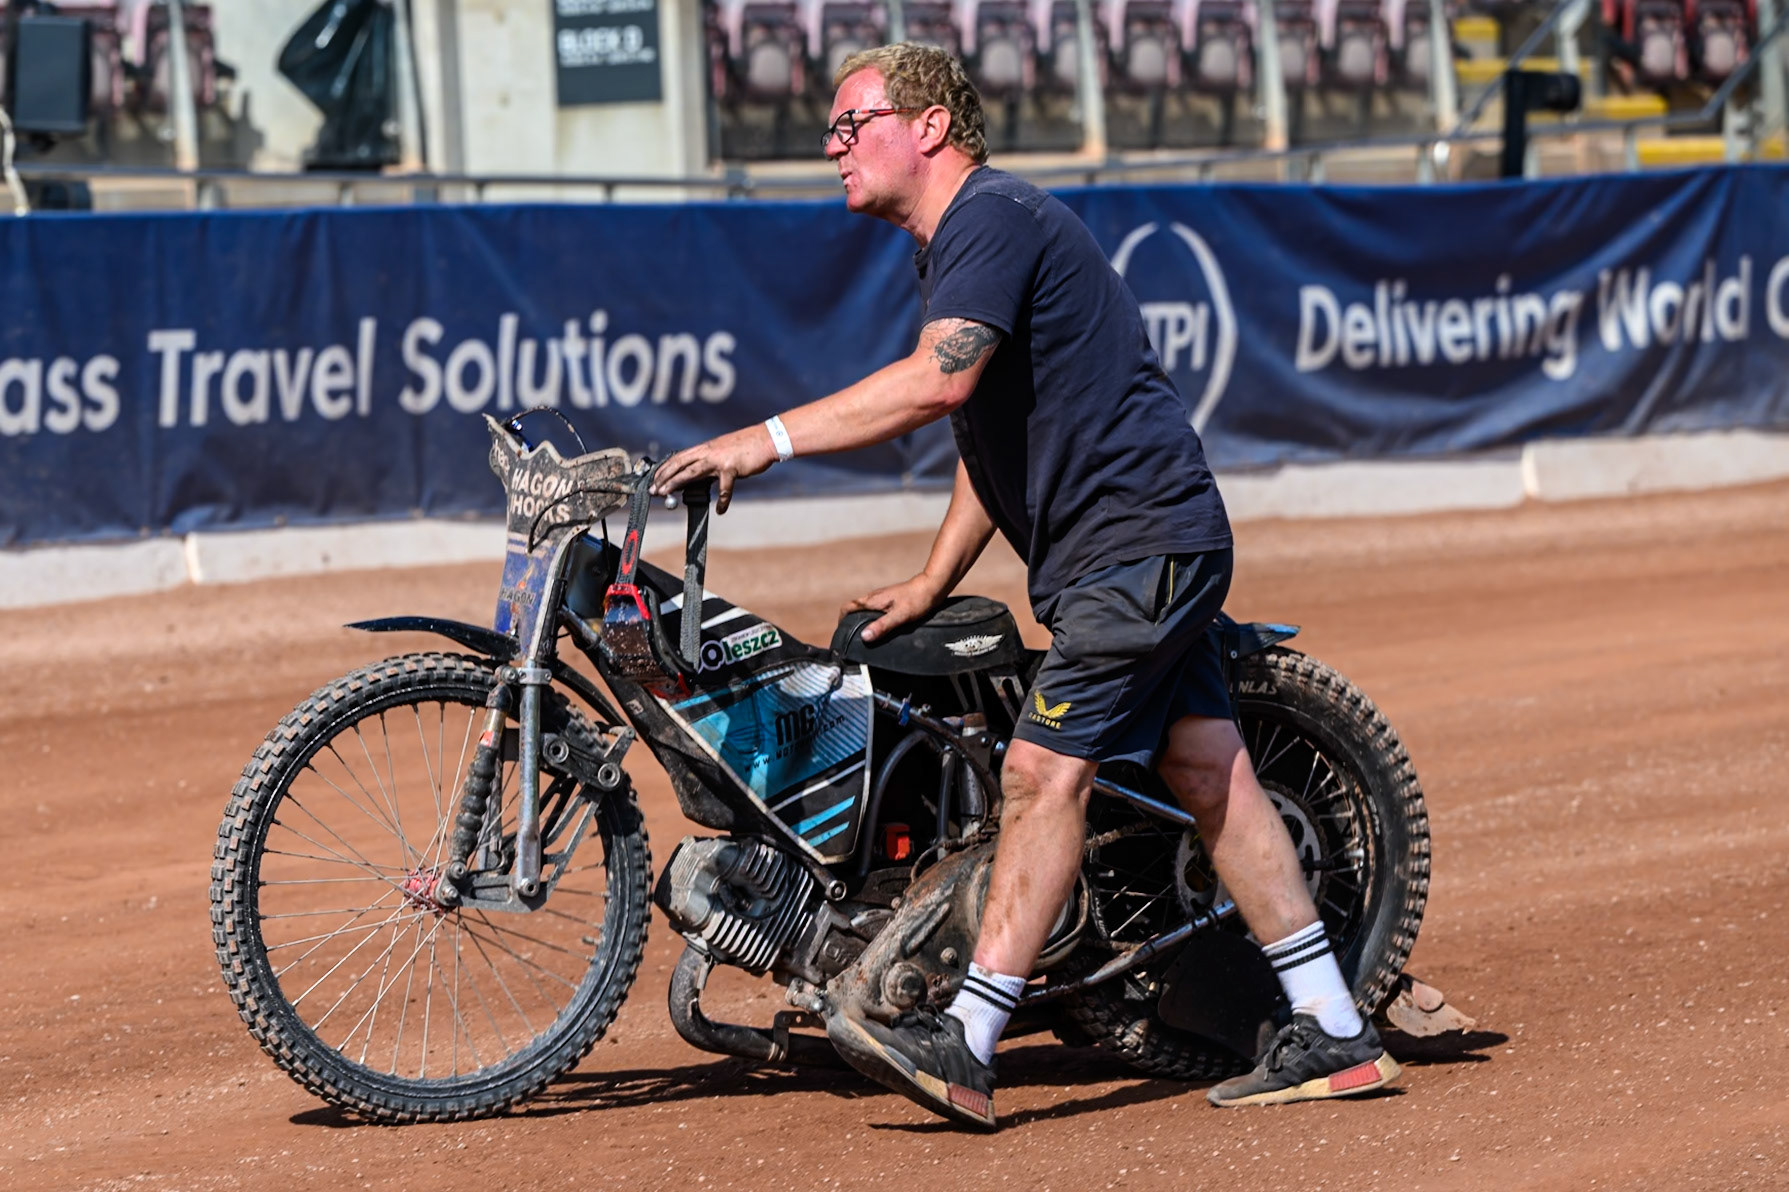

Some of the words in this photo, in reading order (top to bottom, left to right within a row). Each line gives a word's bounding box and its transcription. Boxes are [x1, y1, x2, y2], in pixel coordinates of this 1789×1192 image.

[148, 316, 377, 428] Travel
[399, 308, 738, 415] Solutions
[1295, 273, 1581, 381] Delivering
[1598, 254, 1752, 352] World
[511, 468, 573, 502] HAGON
